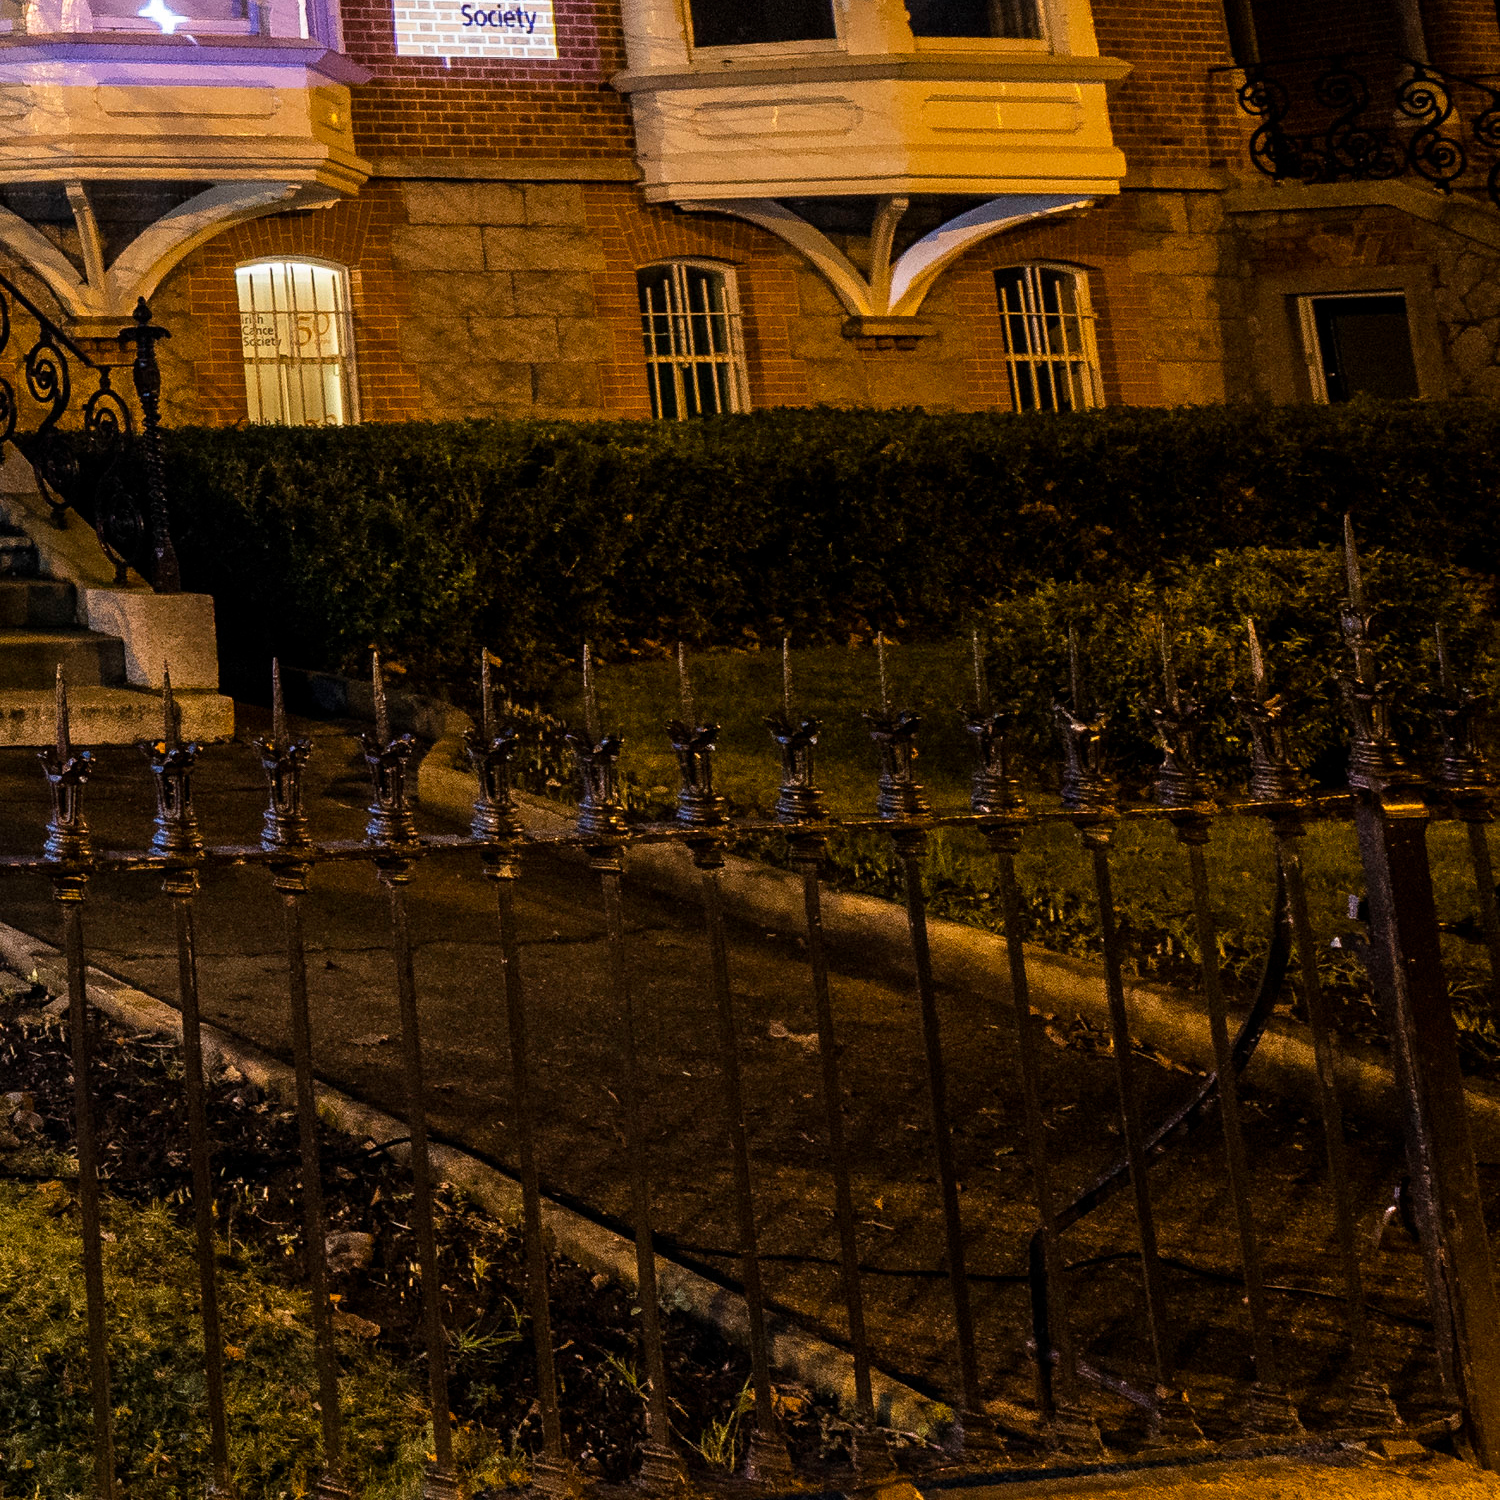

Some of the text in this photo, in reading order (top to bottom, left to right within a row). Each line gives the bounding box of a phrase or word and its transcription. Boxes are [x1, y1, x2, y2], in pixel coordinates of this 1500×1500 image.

[461, 4, 537, 34] Society
[241, 314, 263, 324] Irih
[242, 326, 275, 336] Cance
